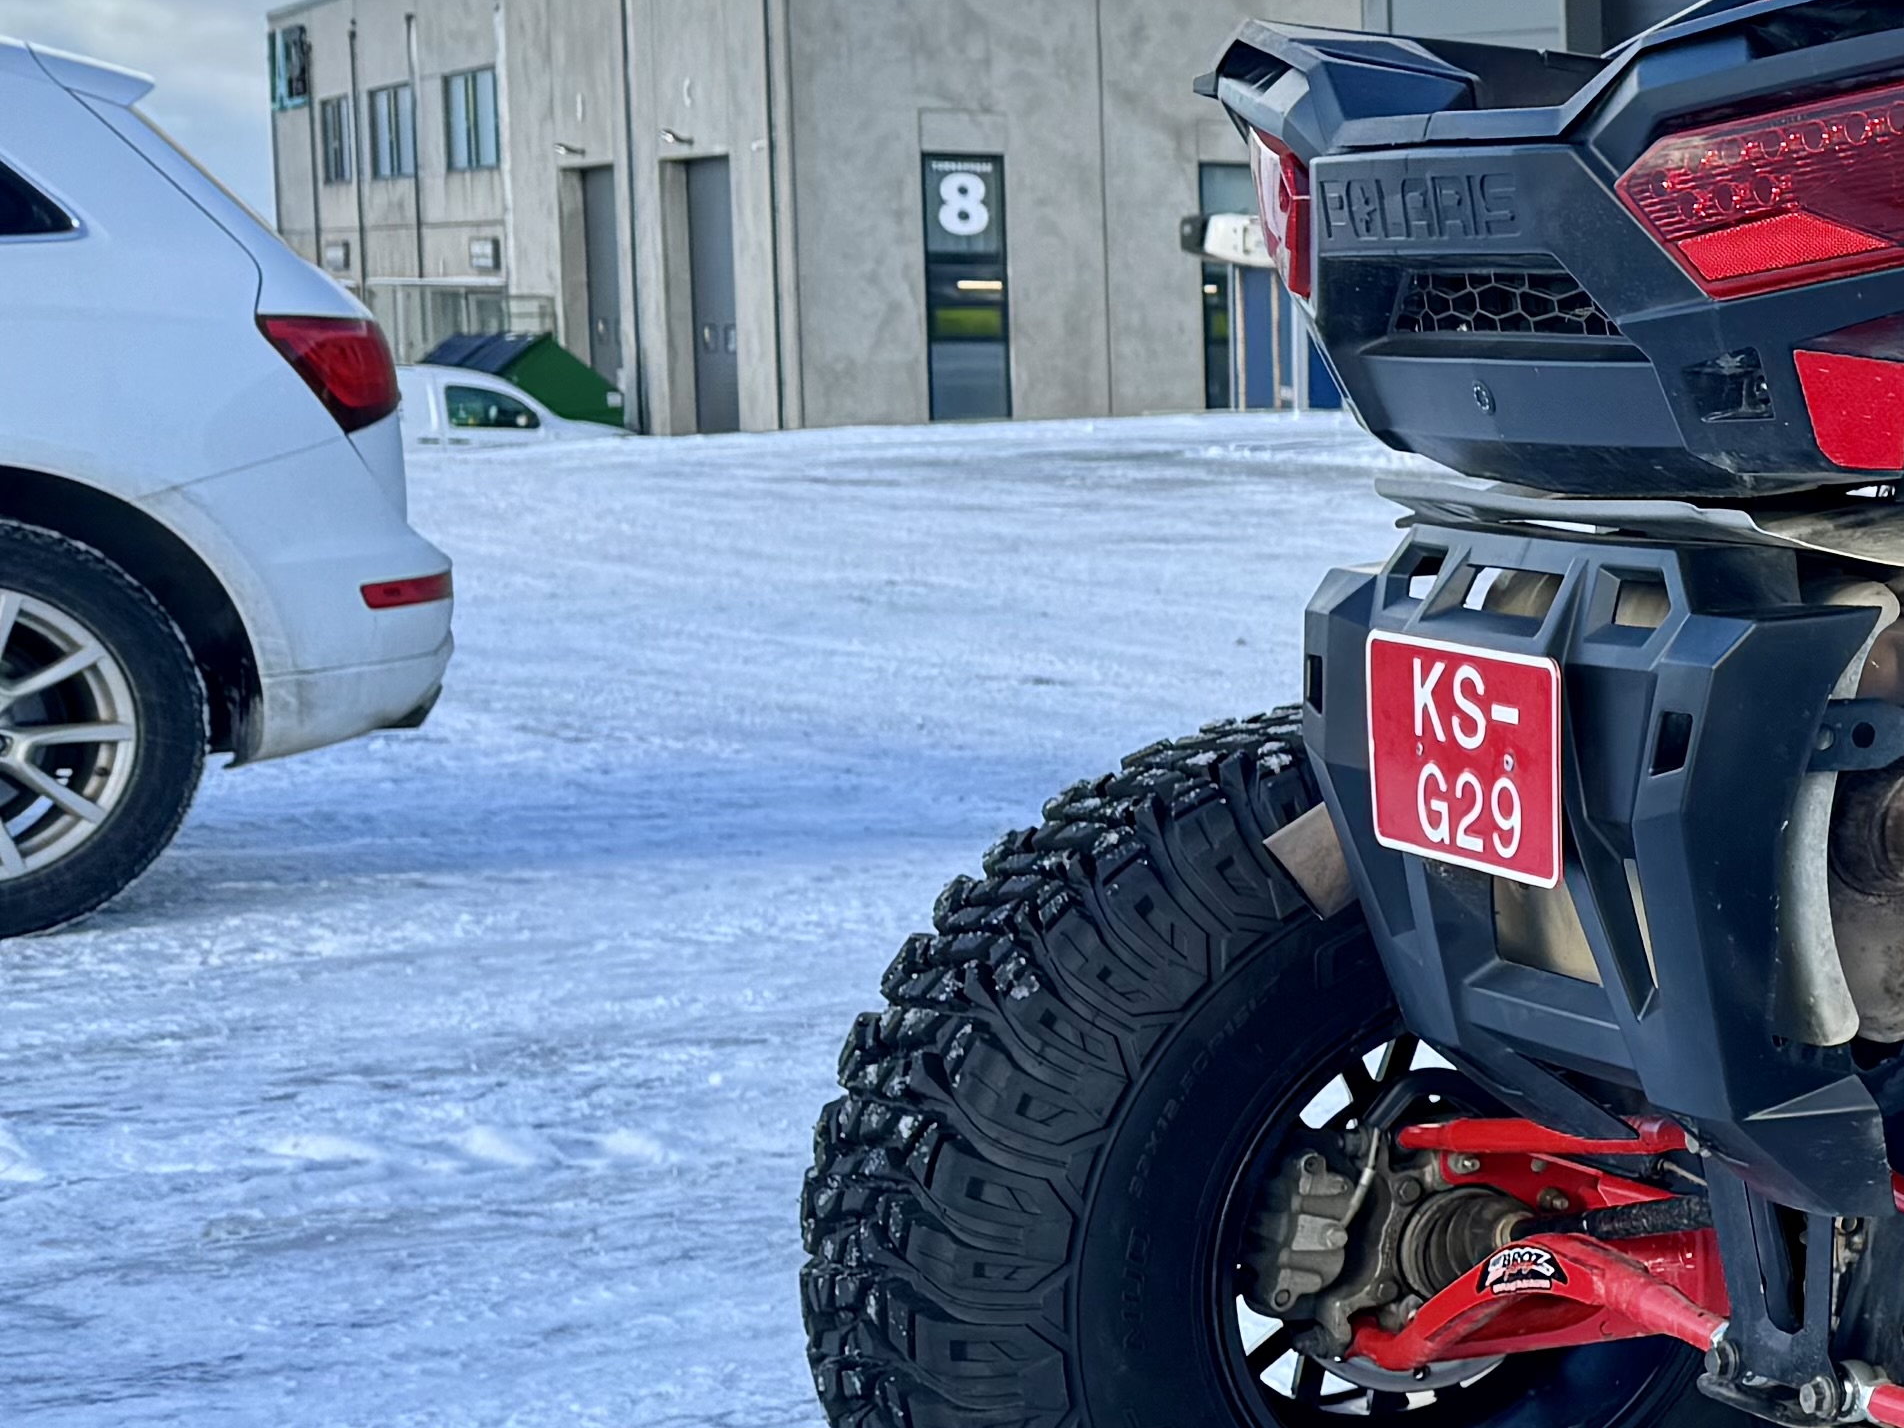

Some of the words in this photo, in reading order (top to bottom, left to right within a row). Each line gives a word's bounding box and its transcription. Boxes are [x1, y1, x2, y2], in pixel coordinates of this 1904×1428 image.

[938, 172, 989, 236] 8
[1320, 173, 1522, 240] POLARIS
[1417, 762, 1522, 859] G29
